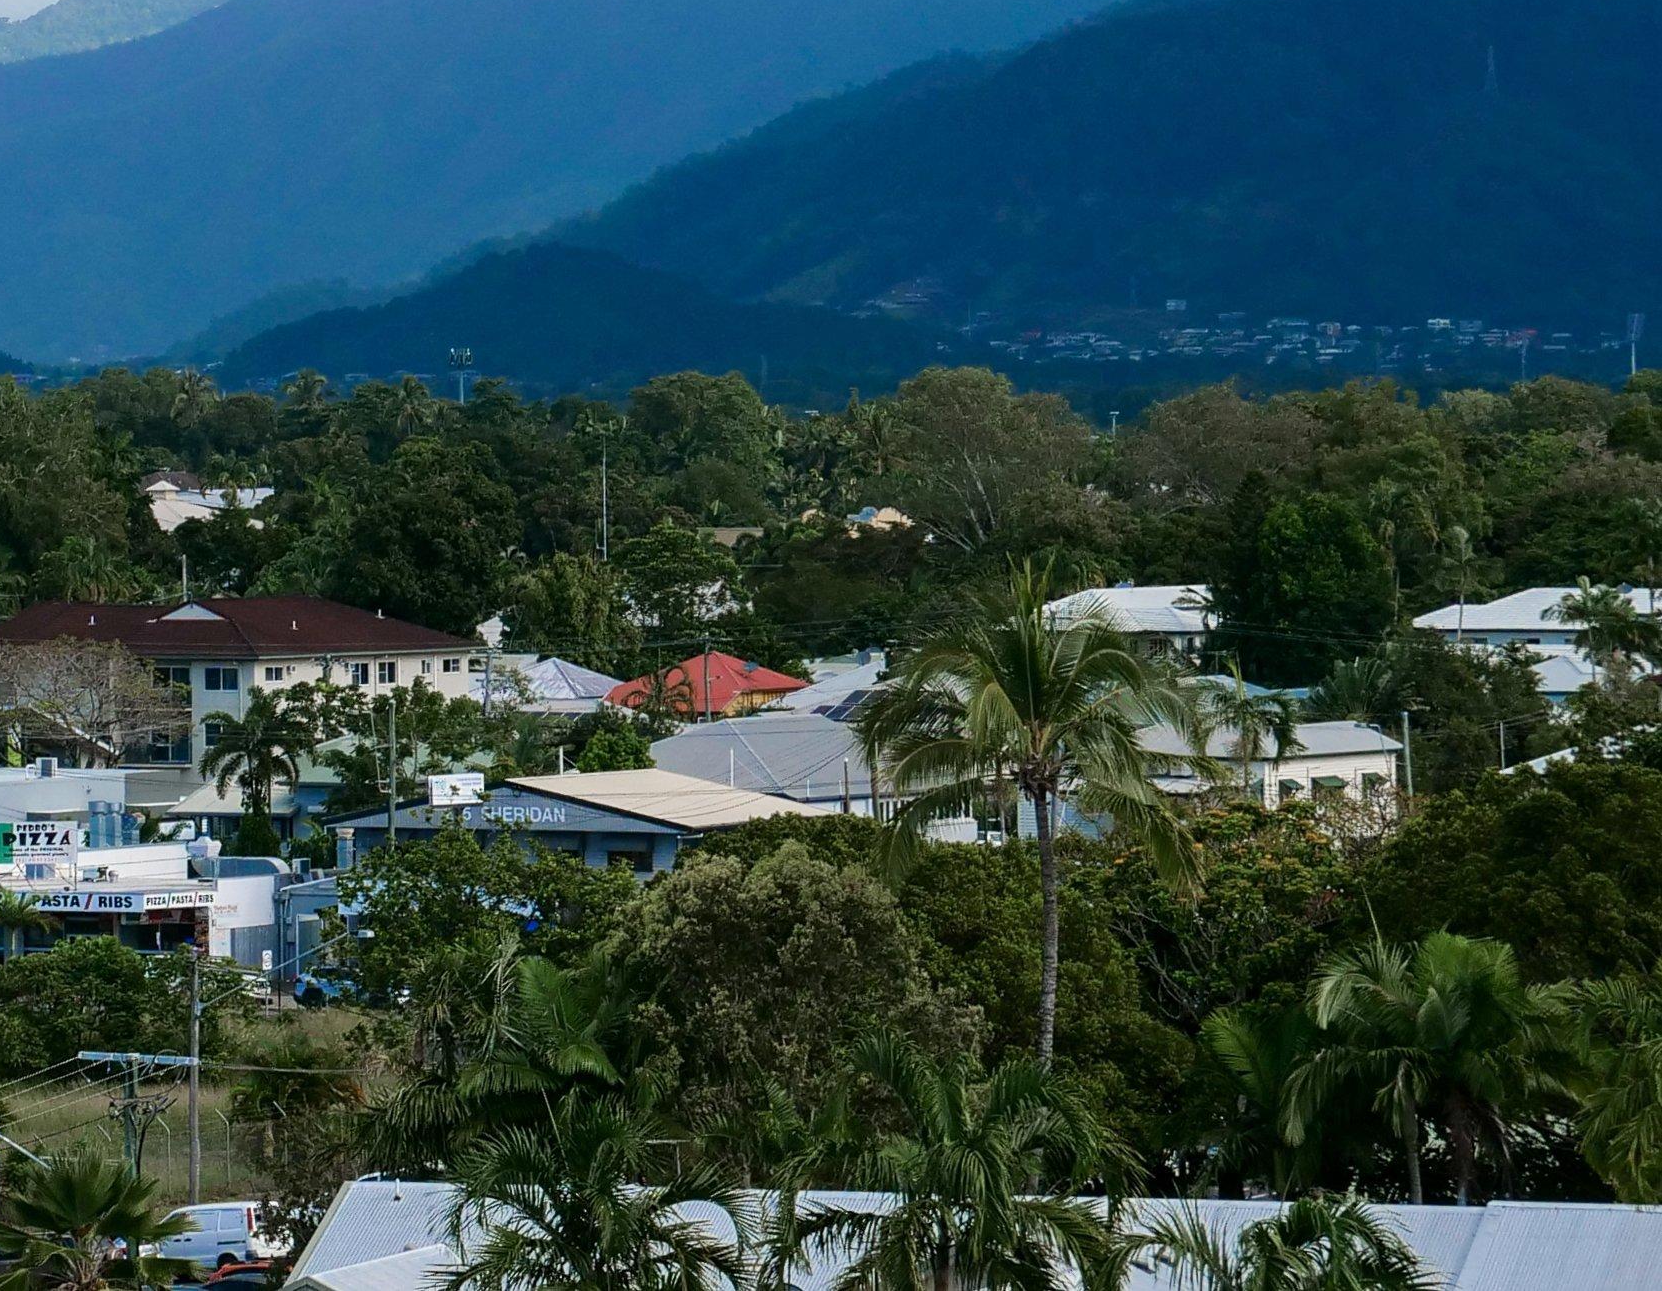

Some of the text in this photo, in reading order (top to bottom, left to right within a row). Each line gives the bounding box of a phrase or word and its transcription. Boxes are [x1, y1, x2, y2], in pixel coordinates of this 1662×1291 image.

[481, 807, 566, 823] SHERIDAN
[2, 830, 71, 847] PIZZA
[32, 895, 81, 908] PASTA
[98, 896, 133, 909] RIBS
[146, 894, 215, 906] PIZZA PASTA RIBS
